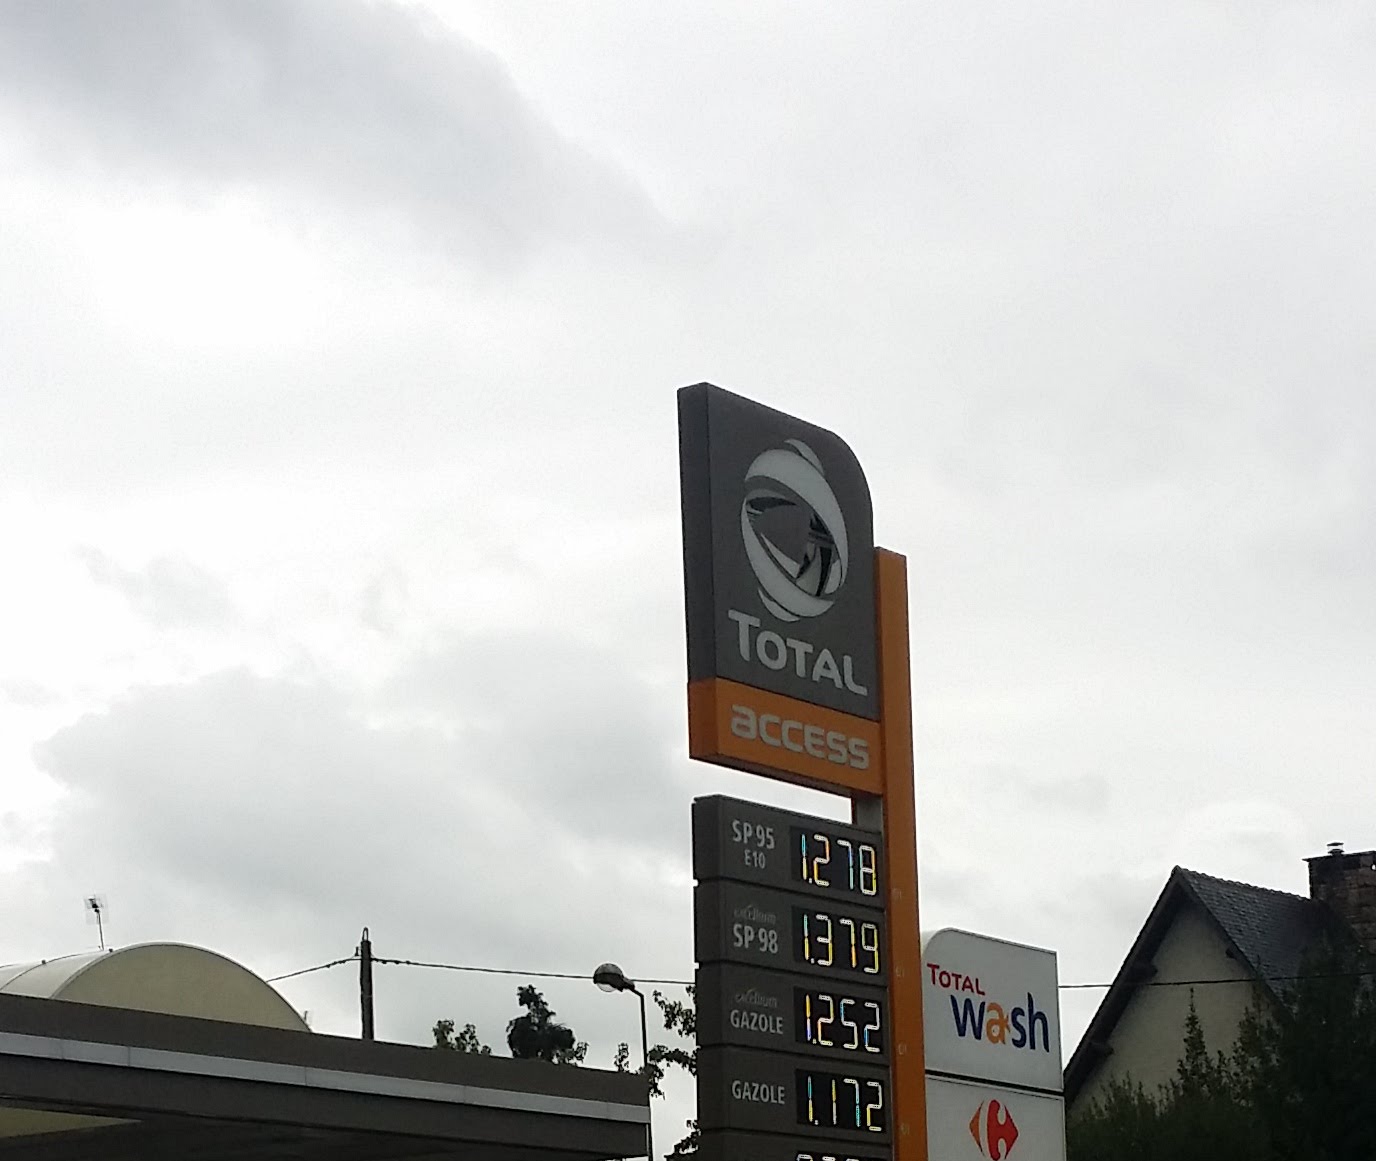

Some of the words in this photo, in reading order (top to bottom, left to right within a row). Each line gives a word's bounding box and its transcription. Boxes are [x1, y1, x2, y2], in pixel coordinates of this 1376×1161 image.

[728, 609, 868, 696] TOTAL
[744, 849, 766, 869] E10
[927, 963, 986, 996] TOTAL
[730, 1009, 784, 1035] GAZOLE
[731, 1079, 786, 1105] GAZOLE
